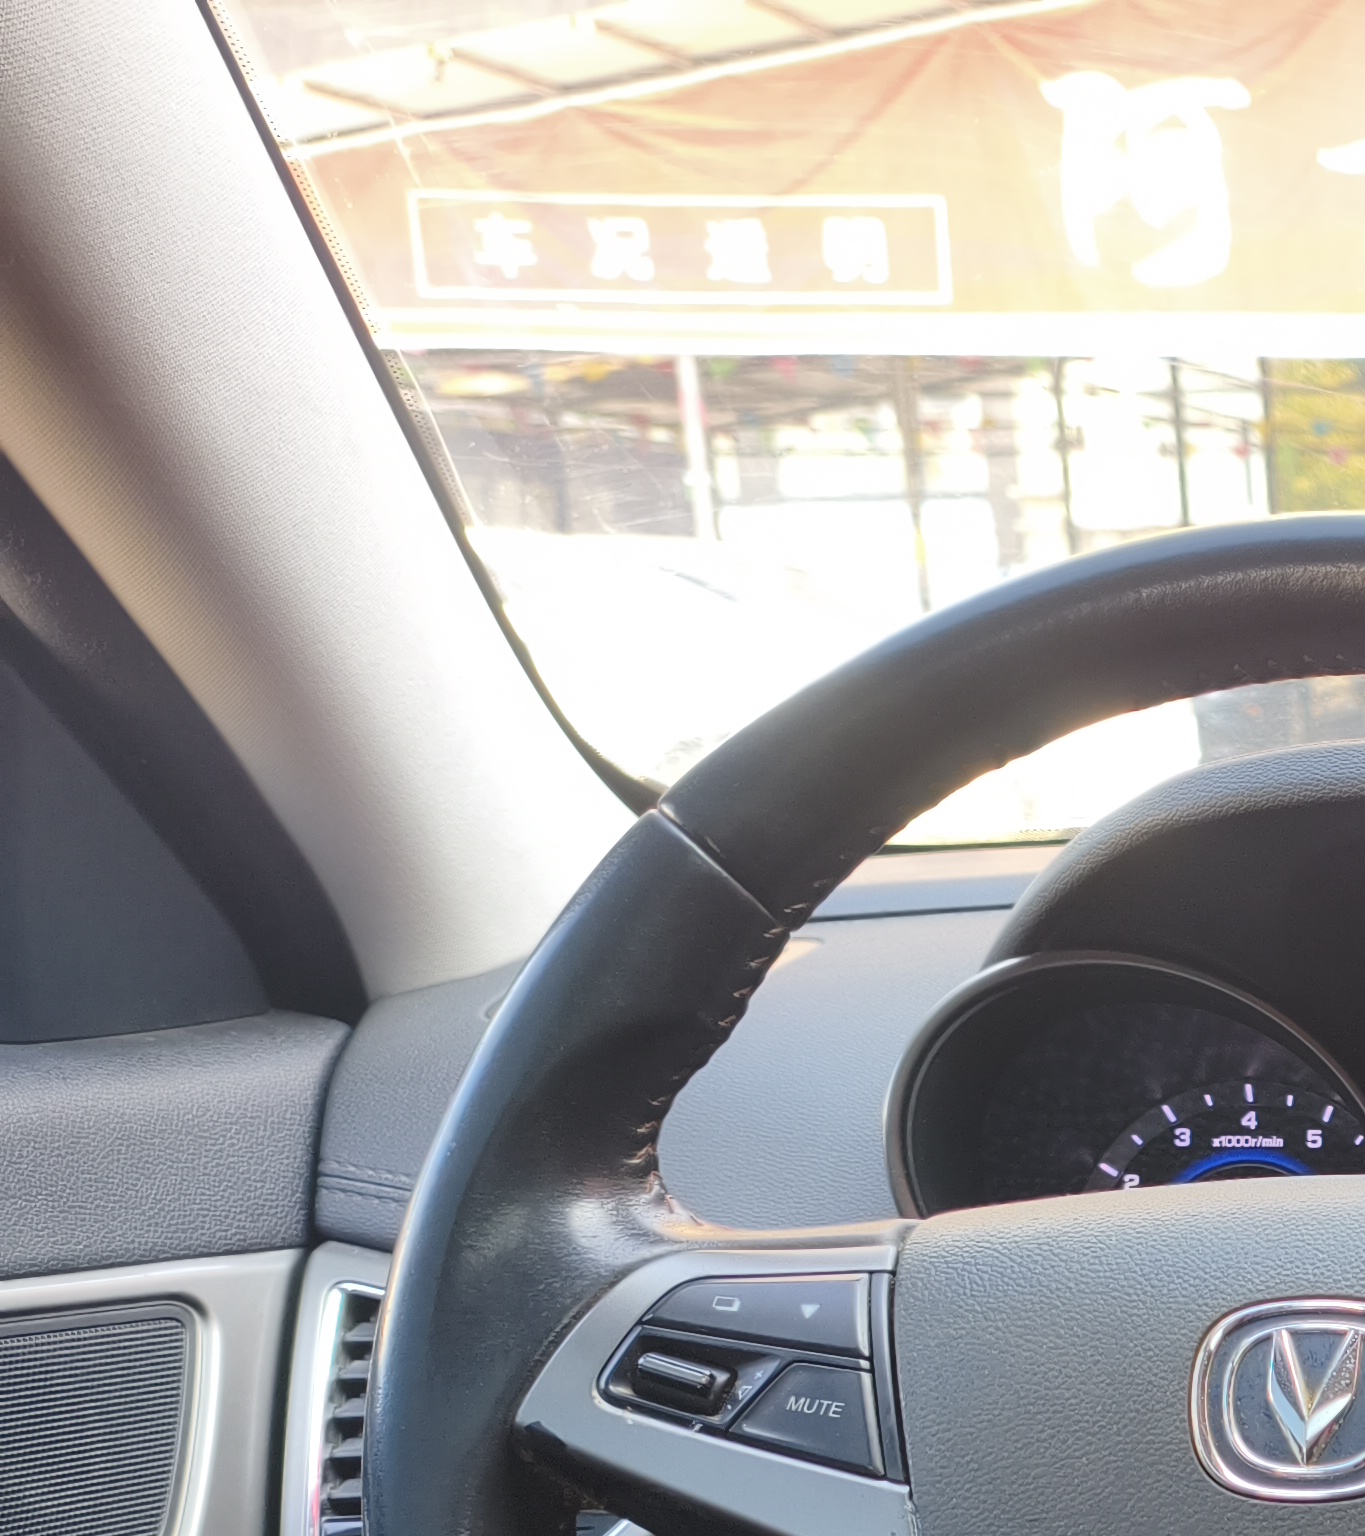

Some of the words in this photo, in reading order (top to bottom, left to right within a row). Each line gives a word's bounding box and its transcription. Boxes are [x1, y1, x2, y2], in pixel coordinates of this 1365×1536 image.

[1240, 1110, 1258, 1130] 4
[1173, 1127, 1191, 1147] 3
[1305, 1129, 1322, 1148] 5
[786, 1396, 846, 1418] MUTE
